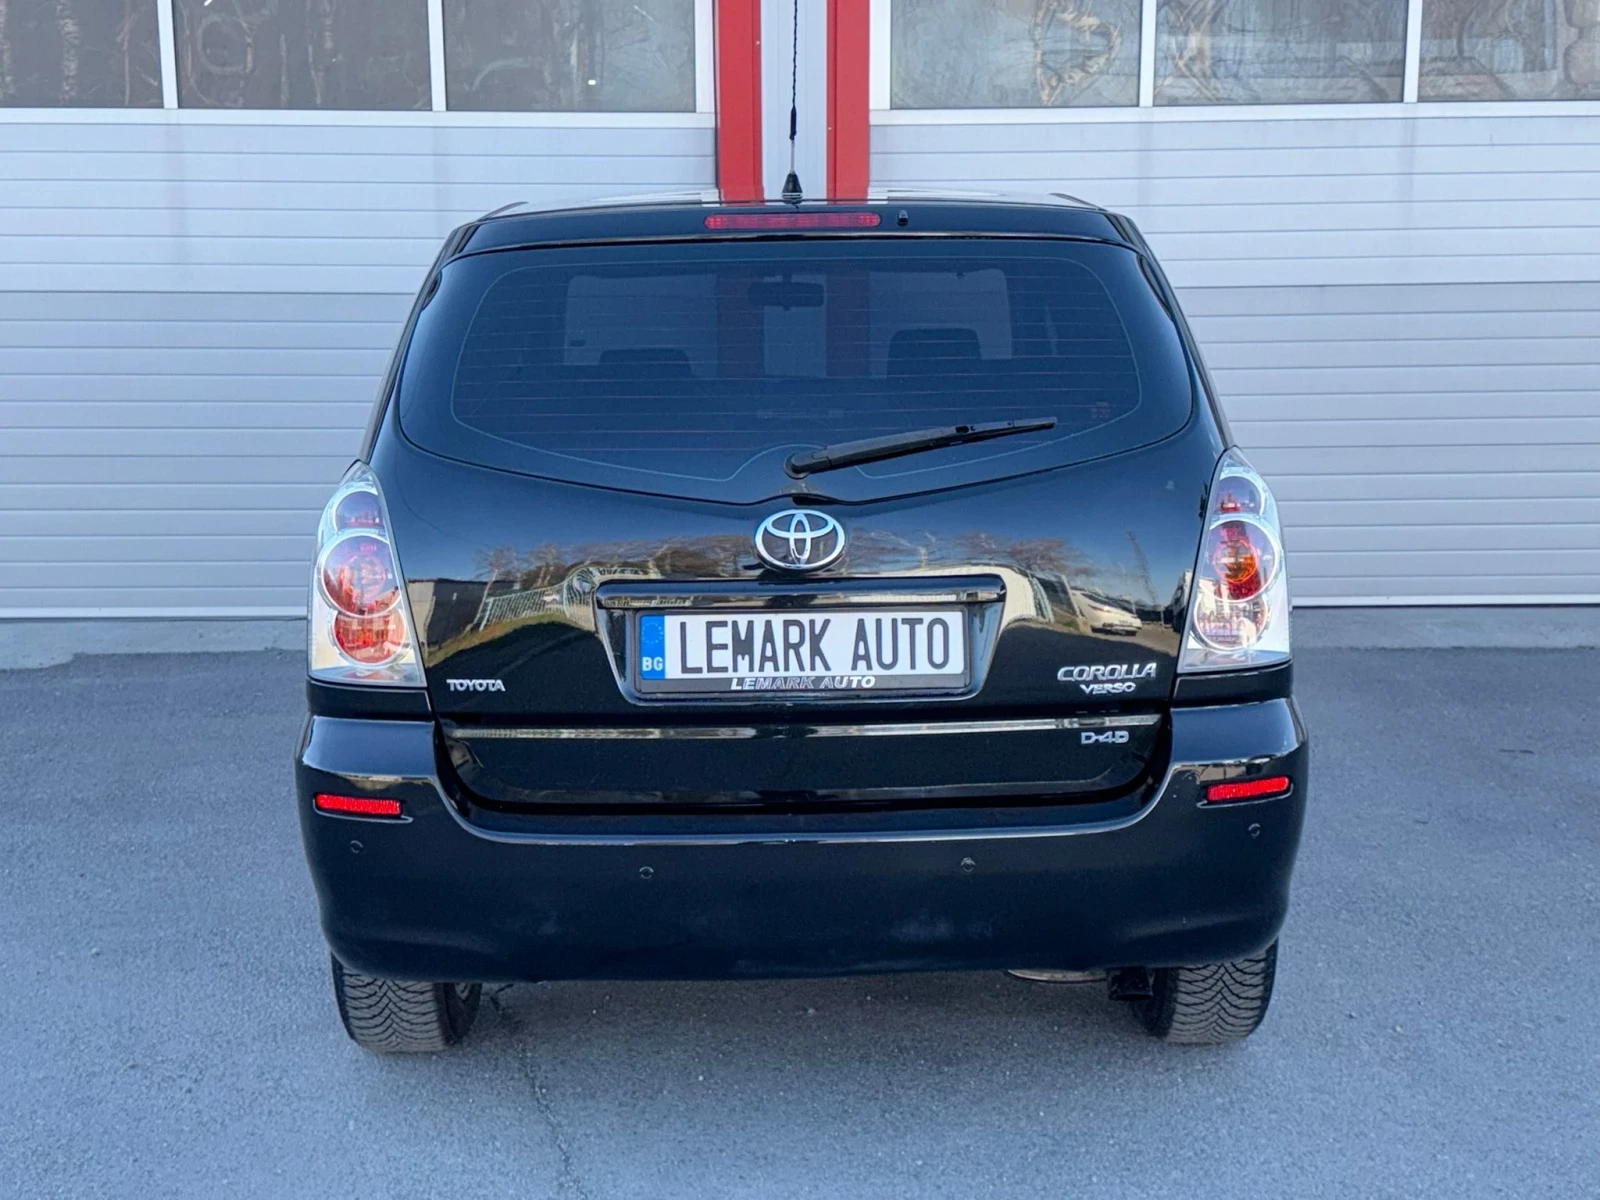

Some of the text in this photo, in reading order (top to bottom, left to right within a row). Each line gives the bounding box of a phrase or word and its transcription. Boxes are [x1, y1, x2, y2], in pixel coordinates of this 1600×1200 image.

[680, 617, 950, 674] LEMARK AUTO
[641, 656, 664, 672] BG
[1057, 662, 1158, 681] COROLLA
[446, 679, 506, 692] TOYOTA
[730, 675, 876, 690] LEMARK AUTO
[1080, 682, 1136, 694] VERSO
[1081, 730, 1130, 744] D-4D
